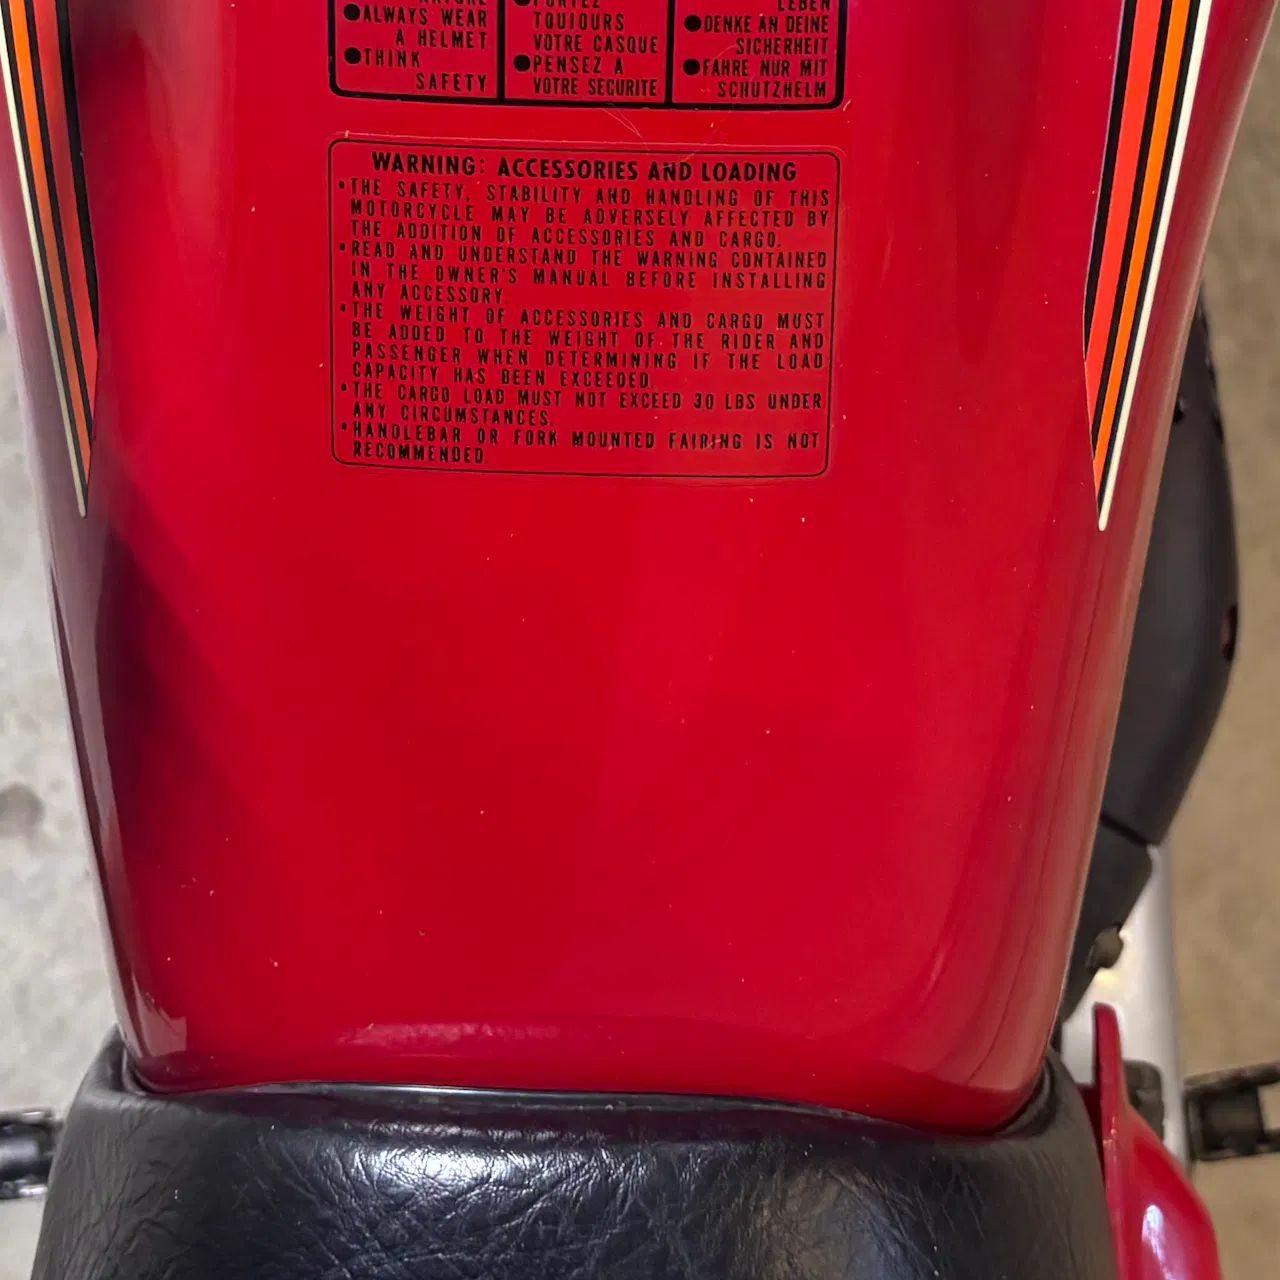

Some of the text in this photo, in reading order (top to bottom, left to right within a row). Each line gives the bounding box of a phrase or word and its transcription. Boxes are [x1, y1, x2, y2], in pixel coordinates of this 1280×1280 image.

[364, 4, 487, 28] ALWAYS WEAR
[534, 12, 624, 32] TOUJOURS
[704, 15, 828, 34] DENKE AN DEINE
[396, 29, 487, 49] A HELMET
[534, 34, 658, 54] VOTRE CASQUE
[736, 37, 828, 55] SICHERHEIT
[364, 48, 420, 68] THINK
[534, 55, 623, 74] PENSEZ A
[703, 59, 828, 77] FAHRE NUR MIT
[416, 73, 486, 92] SAFETY
[534, 77, 657, 96] VOTRE SECURITE
[718, 81, 826, 98] SCHUTZHELM
[372, 152, 796, 182] WARNING: ACCESSORIES AND LOADING
[351, 178, 828, 207] THE SAFETY, STABILITY AND HANDLING OF THIS
[351, 198, 828, 228] MOTORCYCLE MAY BE ADVERSELY AFFECTED BY
[351, 220, 780, 248] THE ADDITION OF ACCESSORIES AND CARGO.
[352, 240, 826, 268] READ AND UNDERSTAND THE WARNING CONTAINED
[352, 260, 825, 289] IN THE OWNER'S MANUAL BEFORE INSTALLING
[352, 281, 507, 304] ANY ACCESSORY.
[352, 301, 824, 330] THE WEIGHT OF ACCESSORIES AND CARGO MUST
[352, 321, 823, 350] BE ADDED TO THE WEIGHT OF THE RIDER AND
[353, 341, 822, 370] PASSENGER WHEN DETERMINING IF THE LOAD
[353, 361, 654, 388] CAPACITY HAS BEEN EXCEEDED.
[353, 381, 821, 410] THE CARGO LOAD MUST NOT EXCEED 30 LBS UNDER
[354, 401, 553, 426] ANY CIRCUMSTANCES.
[354, 421, 818, 450] HANDLEBAR OR FORK MOUNTED FAIRING IS NOT
[354, 440, 488, 464] RECOMMENDED.
